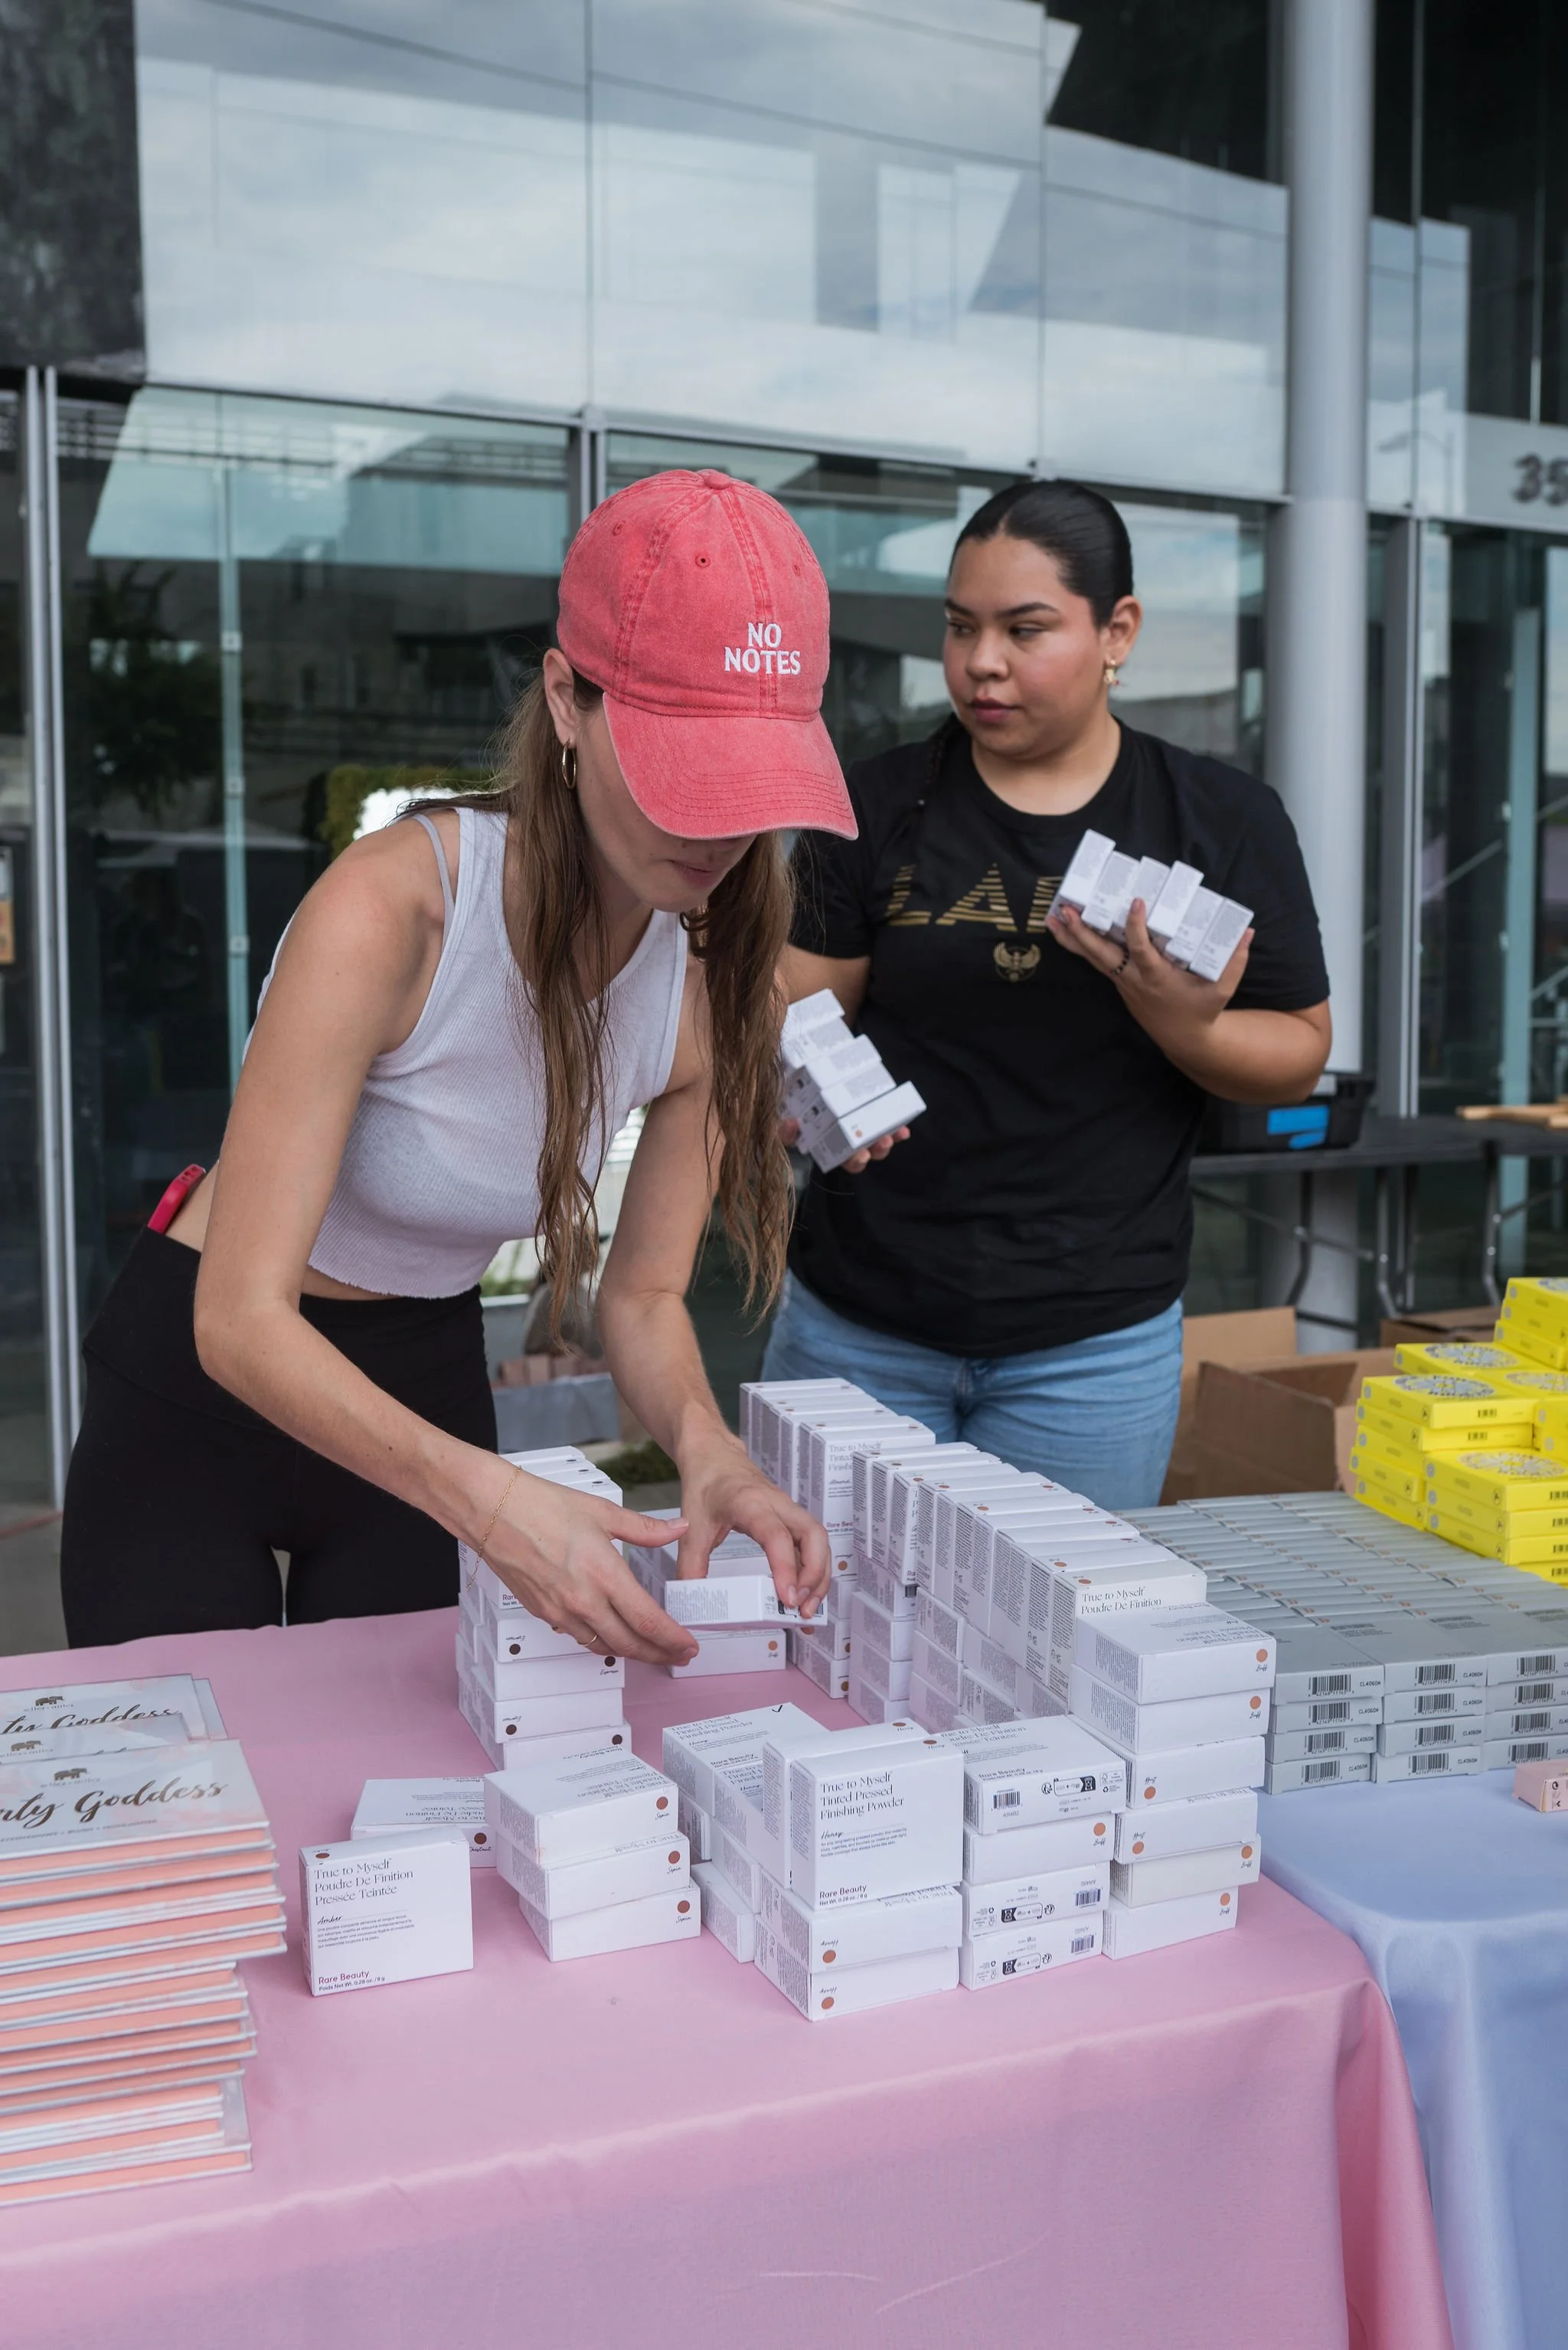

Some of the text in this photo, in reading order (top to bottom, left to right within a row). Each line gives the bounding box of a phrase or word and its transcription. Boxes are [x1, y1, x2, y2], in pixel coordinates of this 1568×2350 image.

[747, 623, 782, 648] NO
[724, 646, 801, 675] NOTES
[1081, 1597, 1162, 1614] Poudre De Finition
[1082, 1586, 1145, 1603] True to Myself
[821, 1771, 891, 1793] True to Myself
[74, 1776, 229, 1824] Goddess
[821, 1784, 893, 1806] Tinted Pressed
[821, 1796, 904, 1820] Finishing Powder
[821, 1830, 842, 1839] Honey
[314, 1858, 390, 1879] True to Myself
[315, 1871, 413, 1893] Poudre De Finition
[819, 1884, 867, 1899] Rare Beauty
[315, 1884, 398, 1906] Pressée Teintée
[317, 1914, 342, 1926] Amber
[318, 1971, 369, 1985] Rare Beauty
